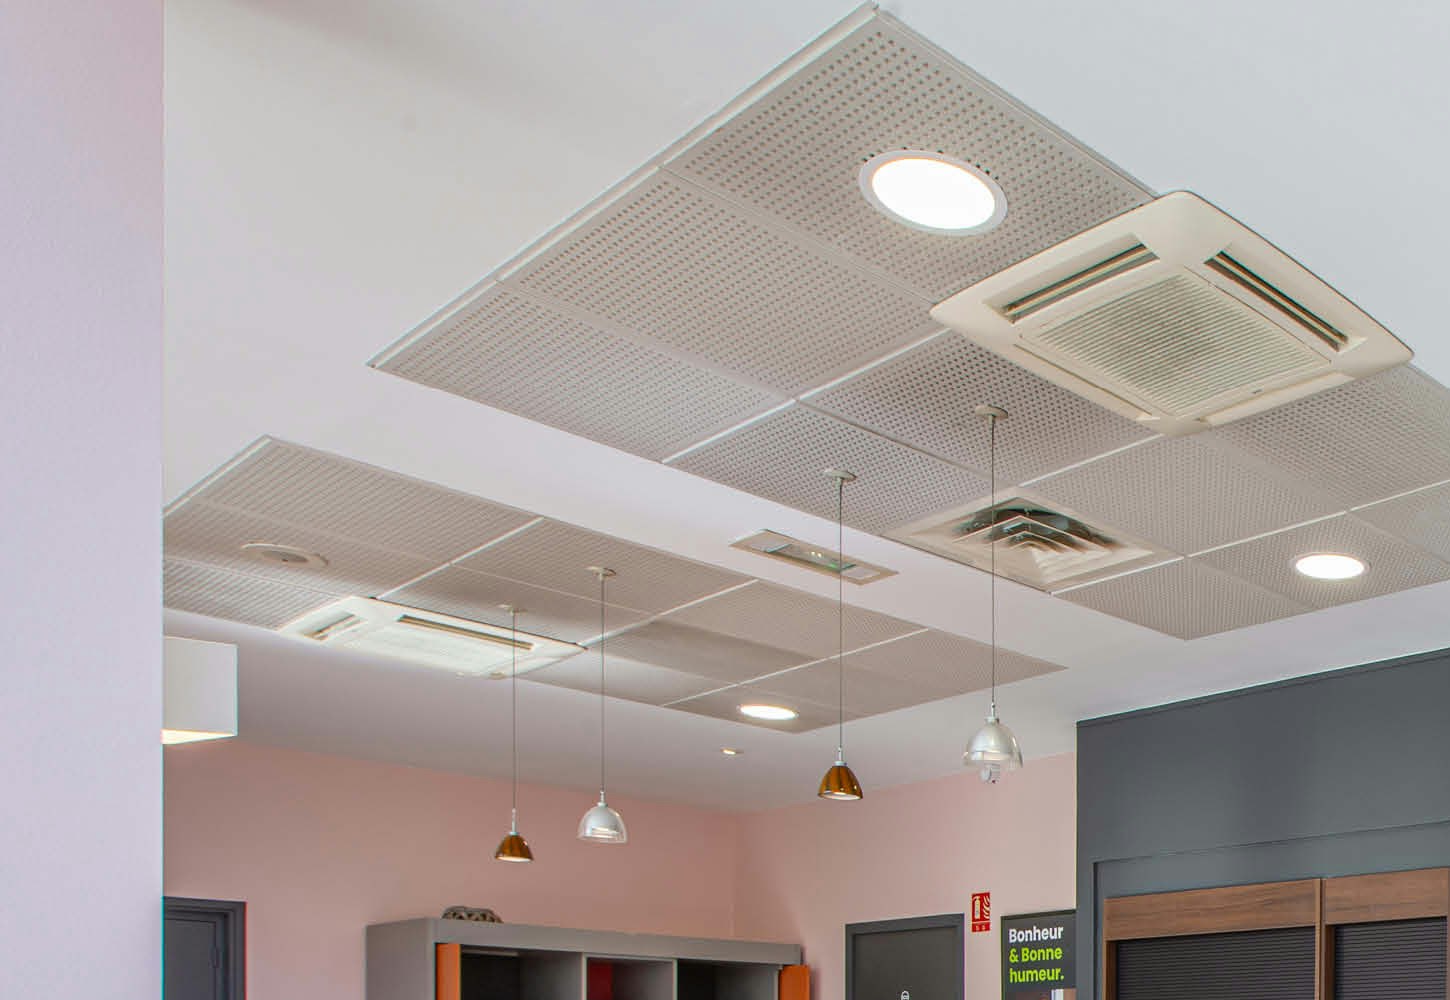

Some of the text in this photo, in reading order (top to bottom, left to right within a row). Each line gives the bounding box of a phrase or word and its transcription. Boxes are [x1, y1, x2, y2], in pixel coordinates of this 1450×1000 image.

[1009, 925, 1064, 943] Bonheur
[1009, 946, 1063, 963] & Bonne
[1009, 967, 1065, 983] humeur.
